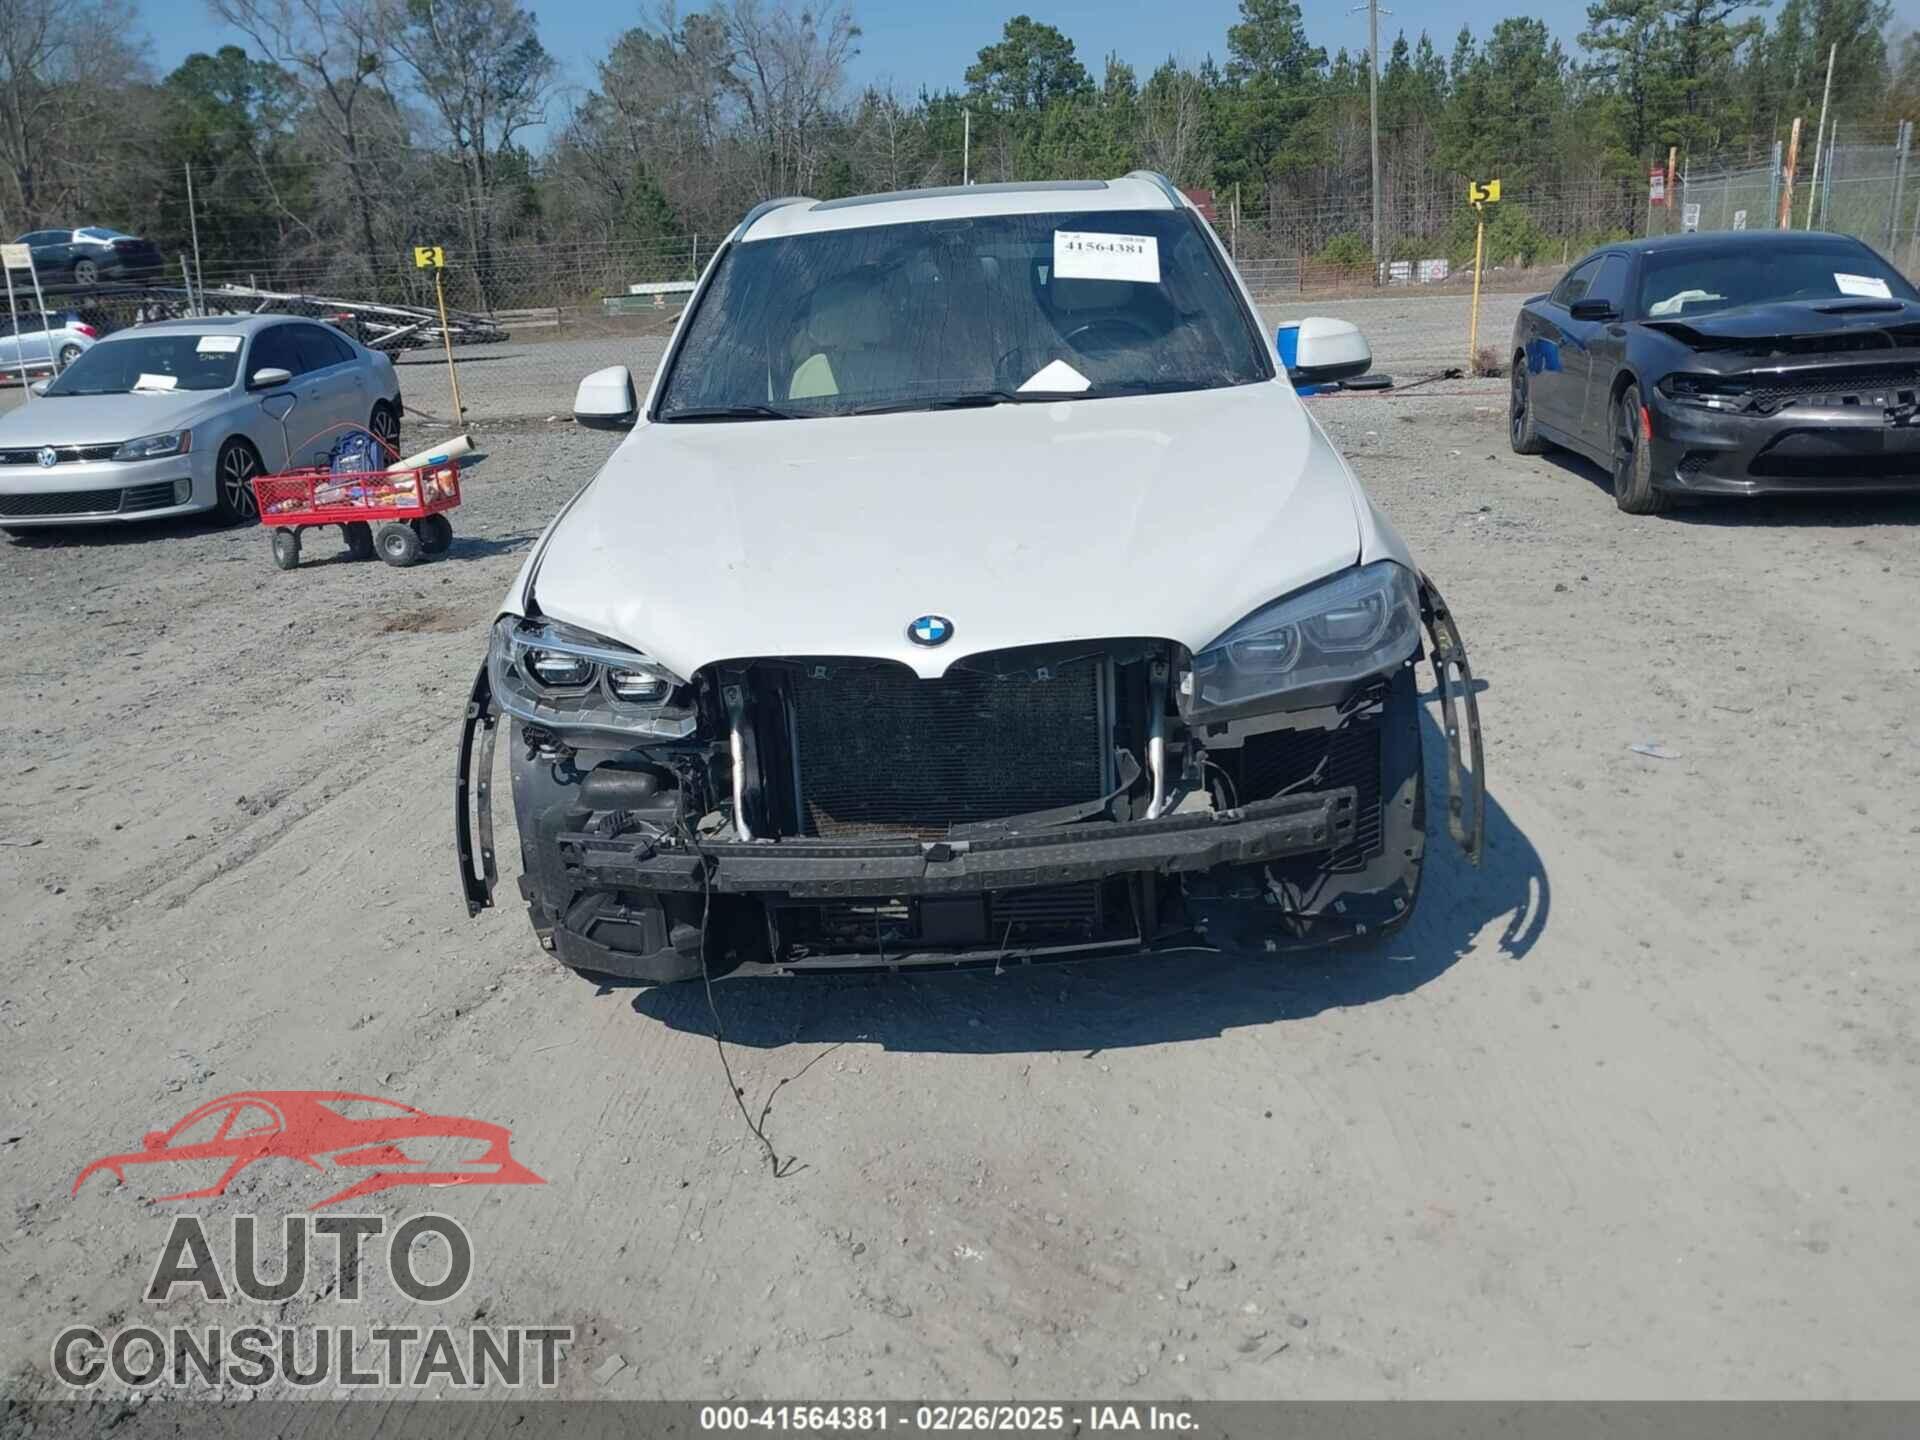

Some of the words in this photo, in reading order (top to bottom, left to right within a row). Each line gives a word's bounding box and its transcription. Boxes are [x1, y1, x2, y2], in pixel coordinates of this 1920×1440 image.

[1474, 181, 1491, 202] 5
[421, 248, 437, 268] 3
[1065, 241, 1144, 255] 41564381
